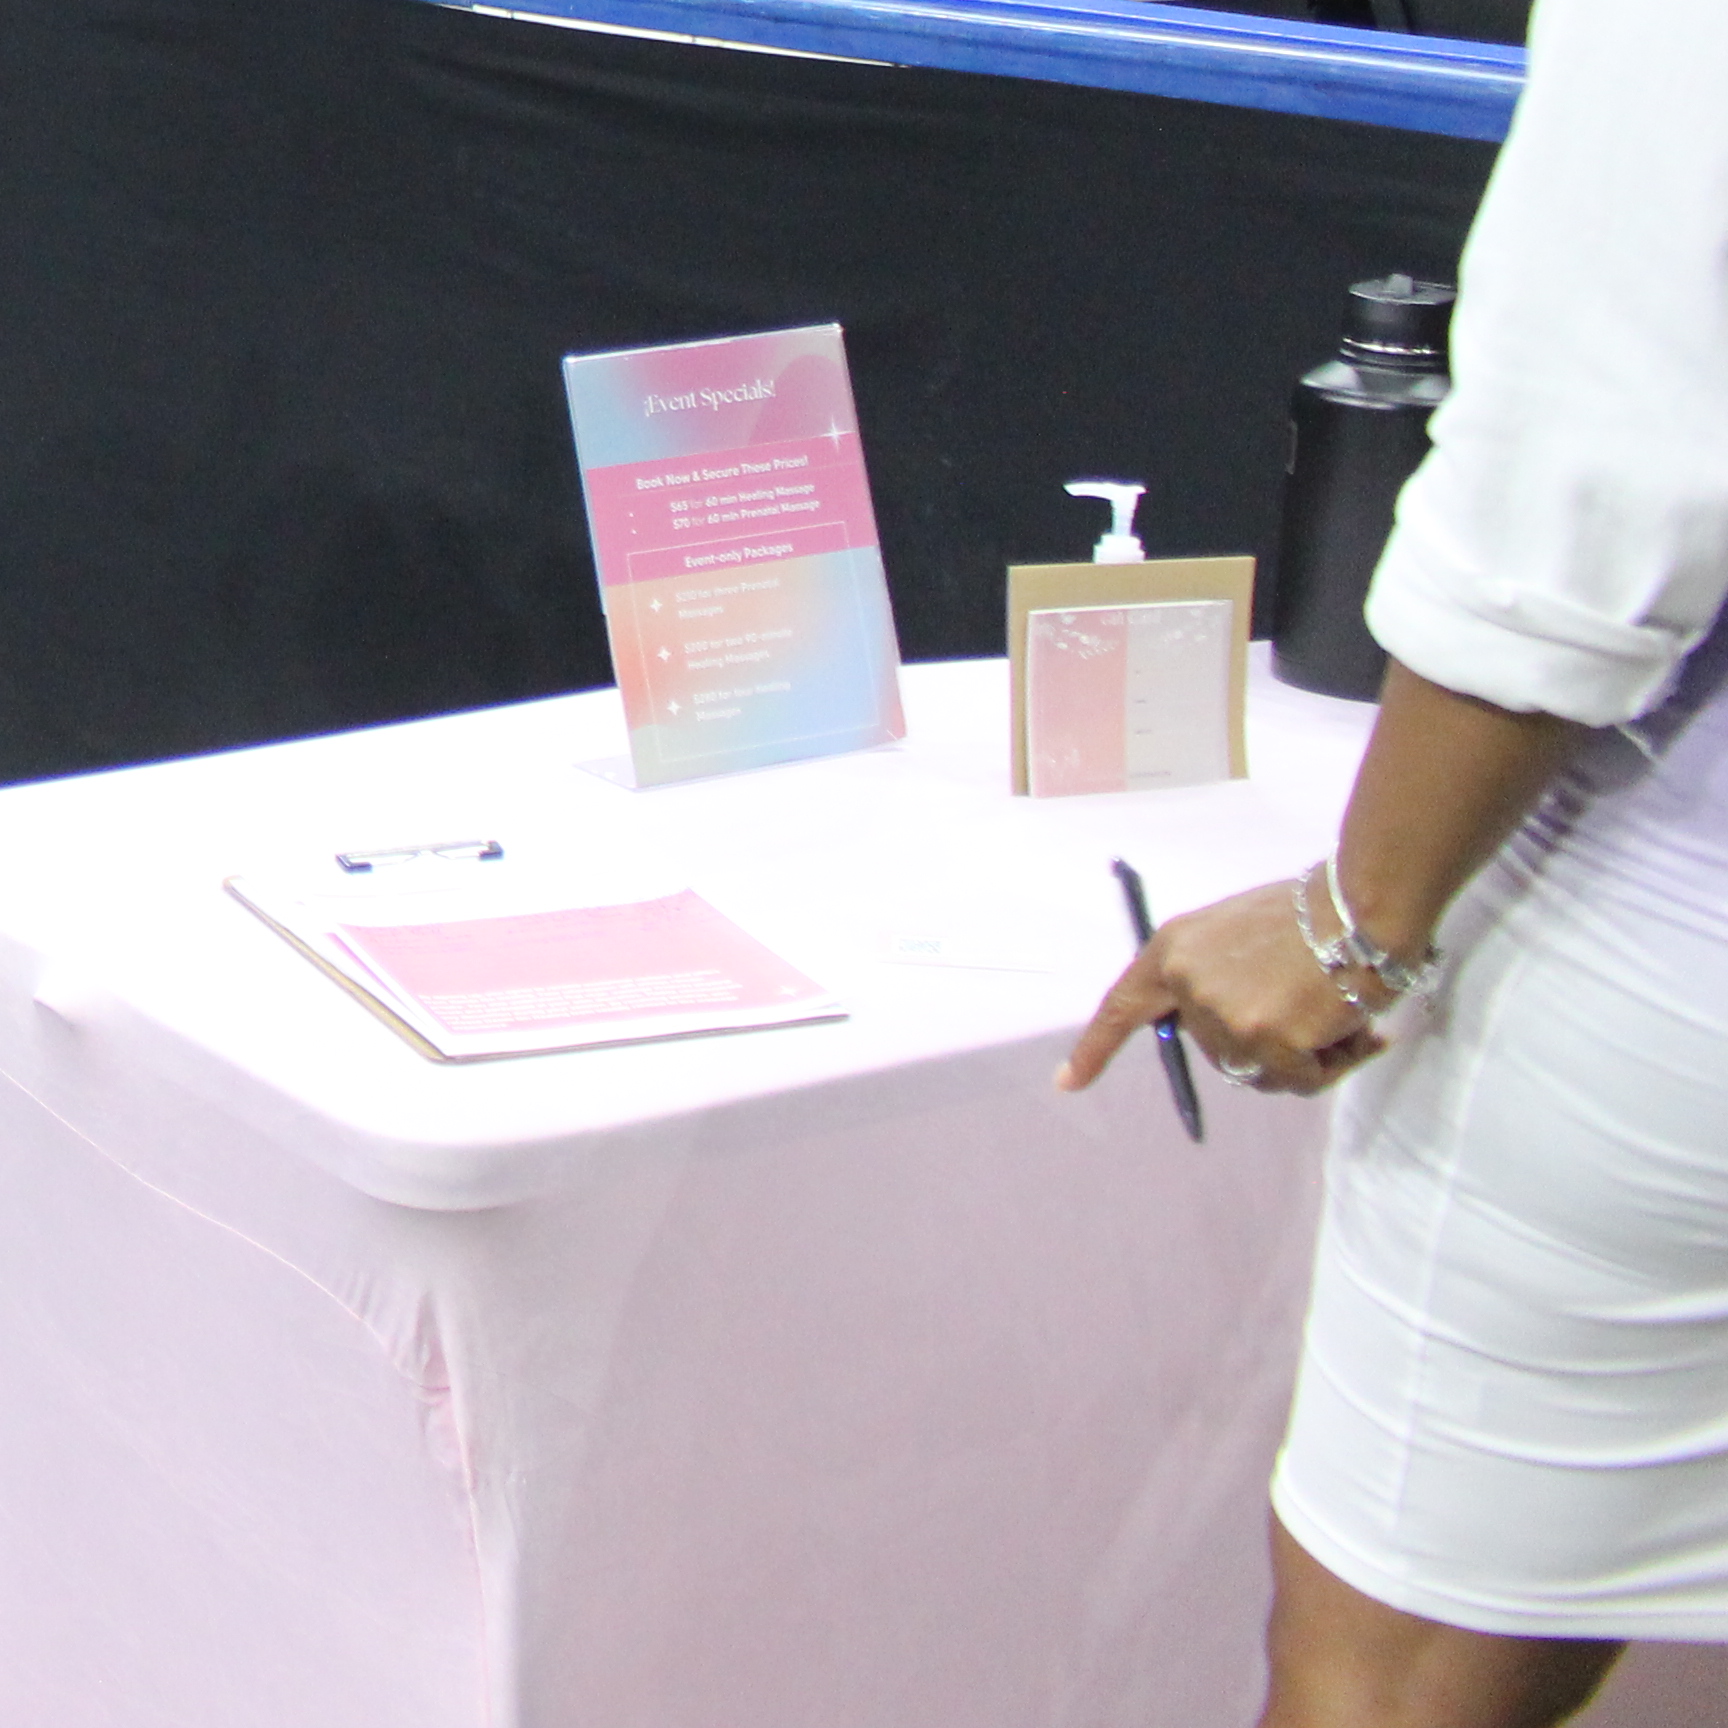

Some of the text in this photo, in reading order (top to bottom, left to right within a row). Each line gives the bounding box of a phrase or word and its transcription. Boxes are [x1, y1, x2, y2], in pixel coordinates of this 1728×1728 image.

[699, 378, 777, 412] Specials!
[635, 454, 809, 491] Book Now & Secure These Prices!
[683, 543, 794, 568] Event-only Packages
